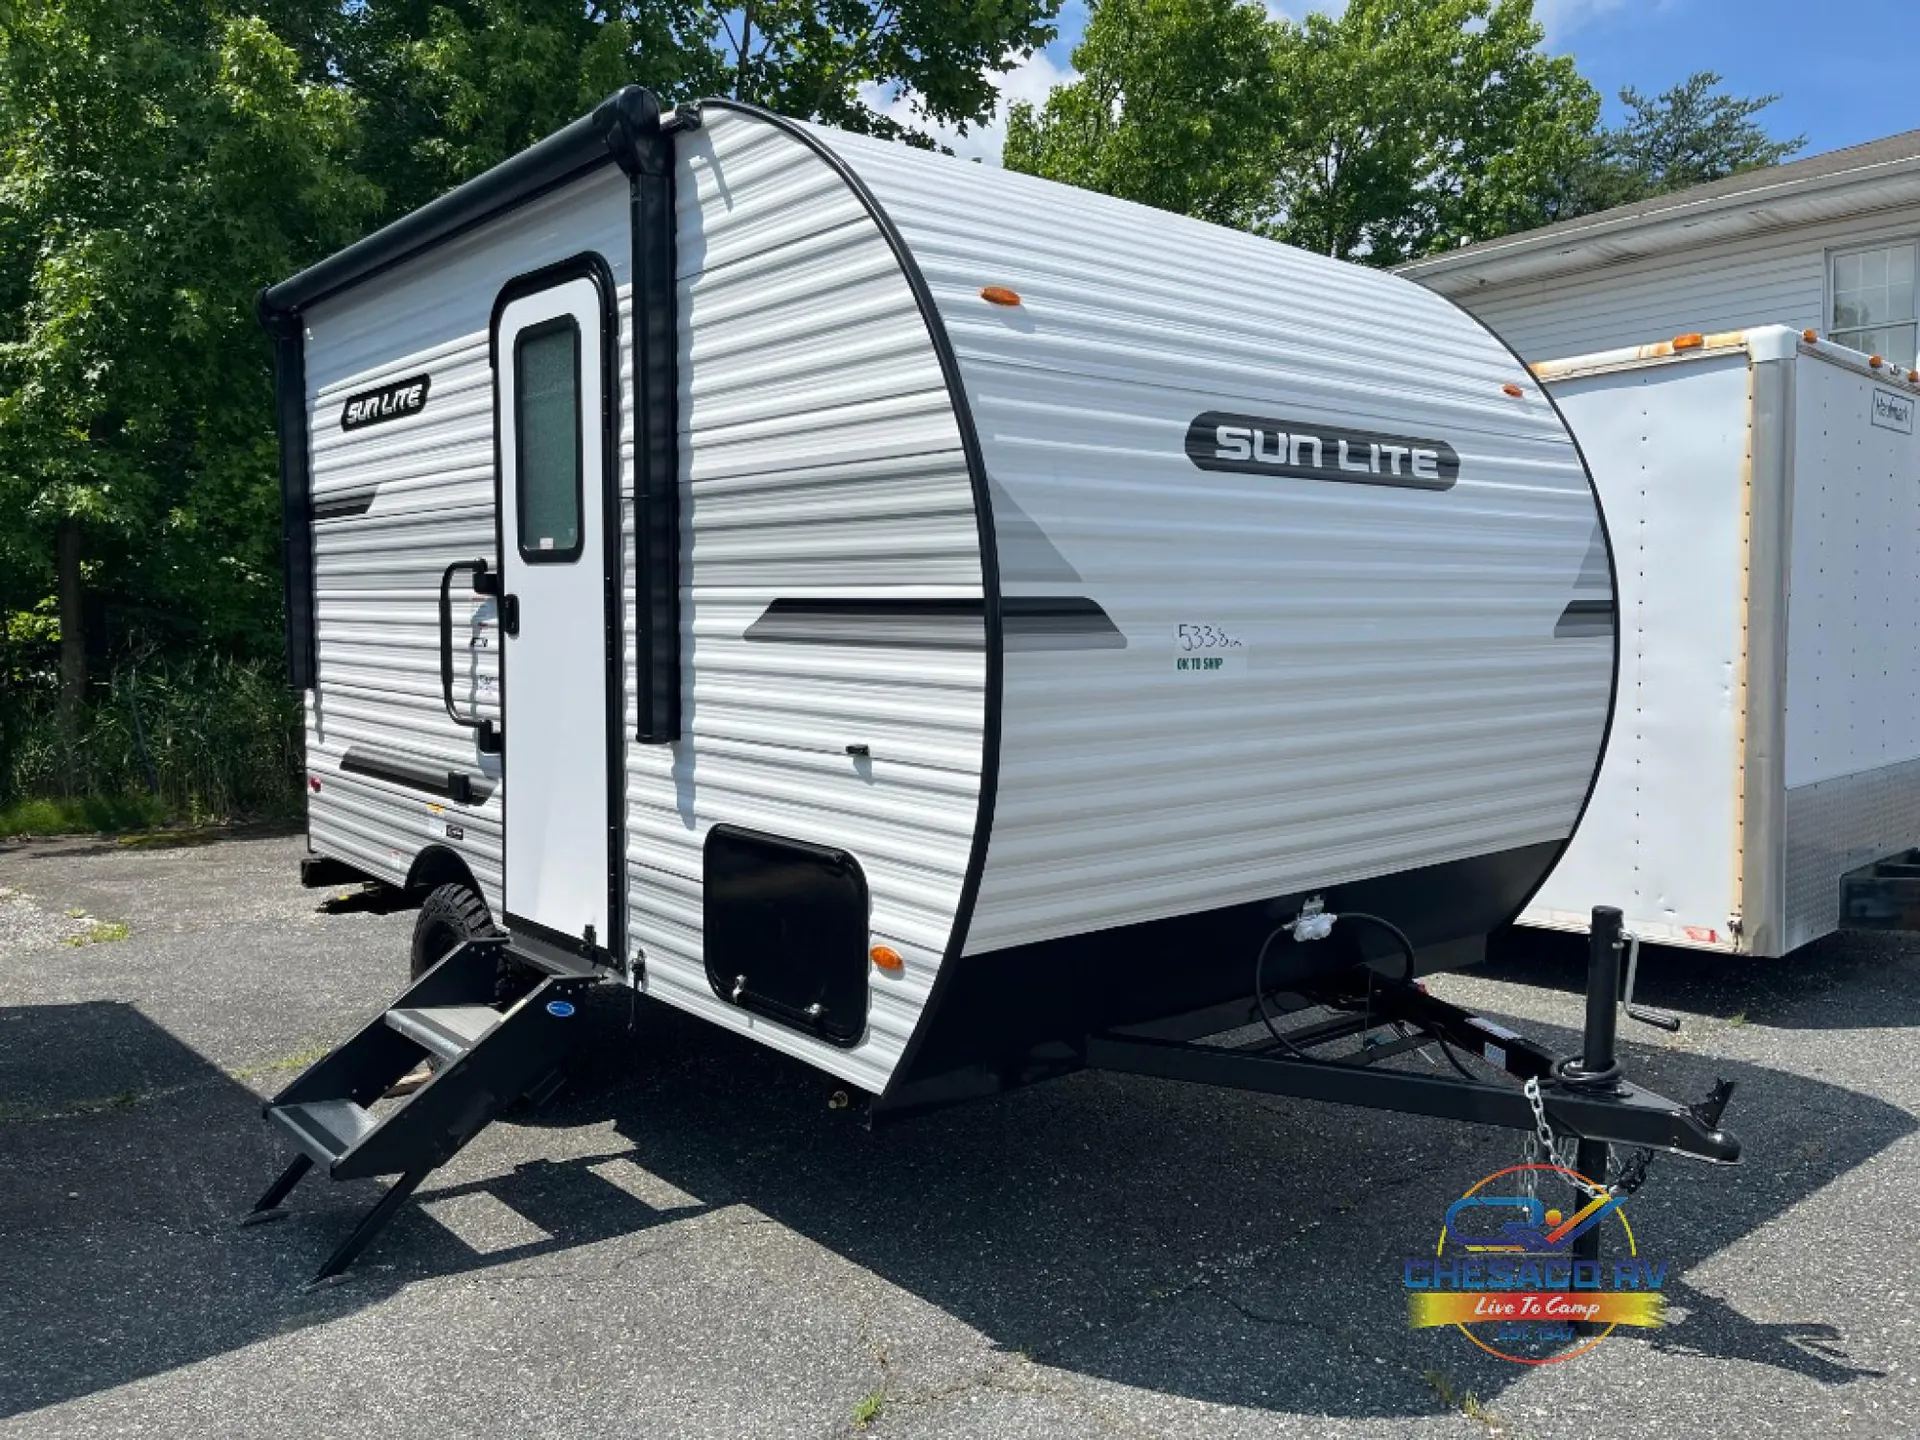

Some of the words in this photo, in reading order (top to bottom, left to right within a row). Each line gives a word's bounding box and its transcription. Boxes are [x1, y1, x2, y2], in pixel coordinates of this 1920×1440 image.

[347, 397, 380, 424] SUN
[382, 384, 423, 415] LITE
[1216, 425, 1323, 468] SUN
[1338, 439, 1439, 479] LITE
[1177, 657, 1190, 670] OK
[1190, 657, 1201, 670] TO
[1203, 657, 1224, 670] SHIP
